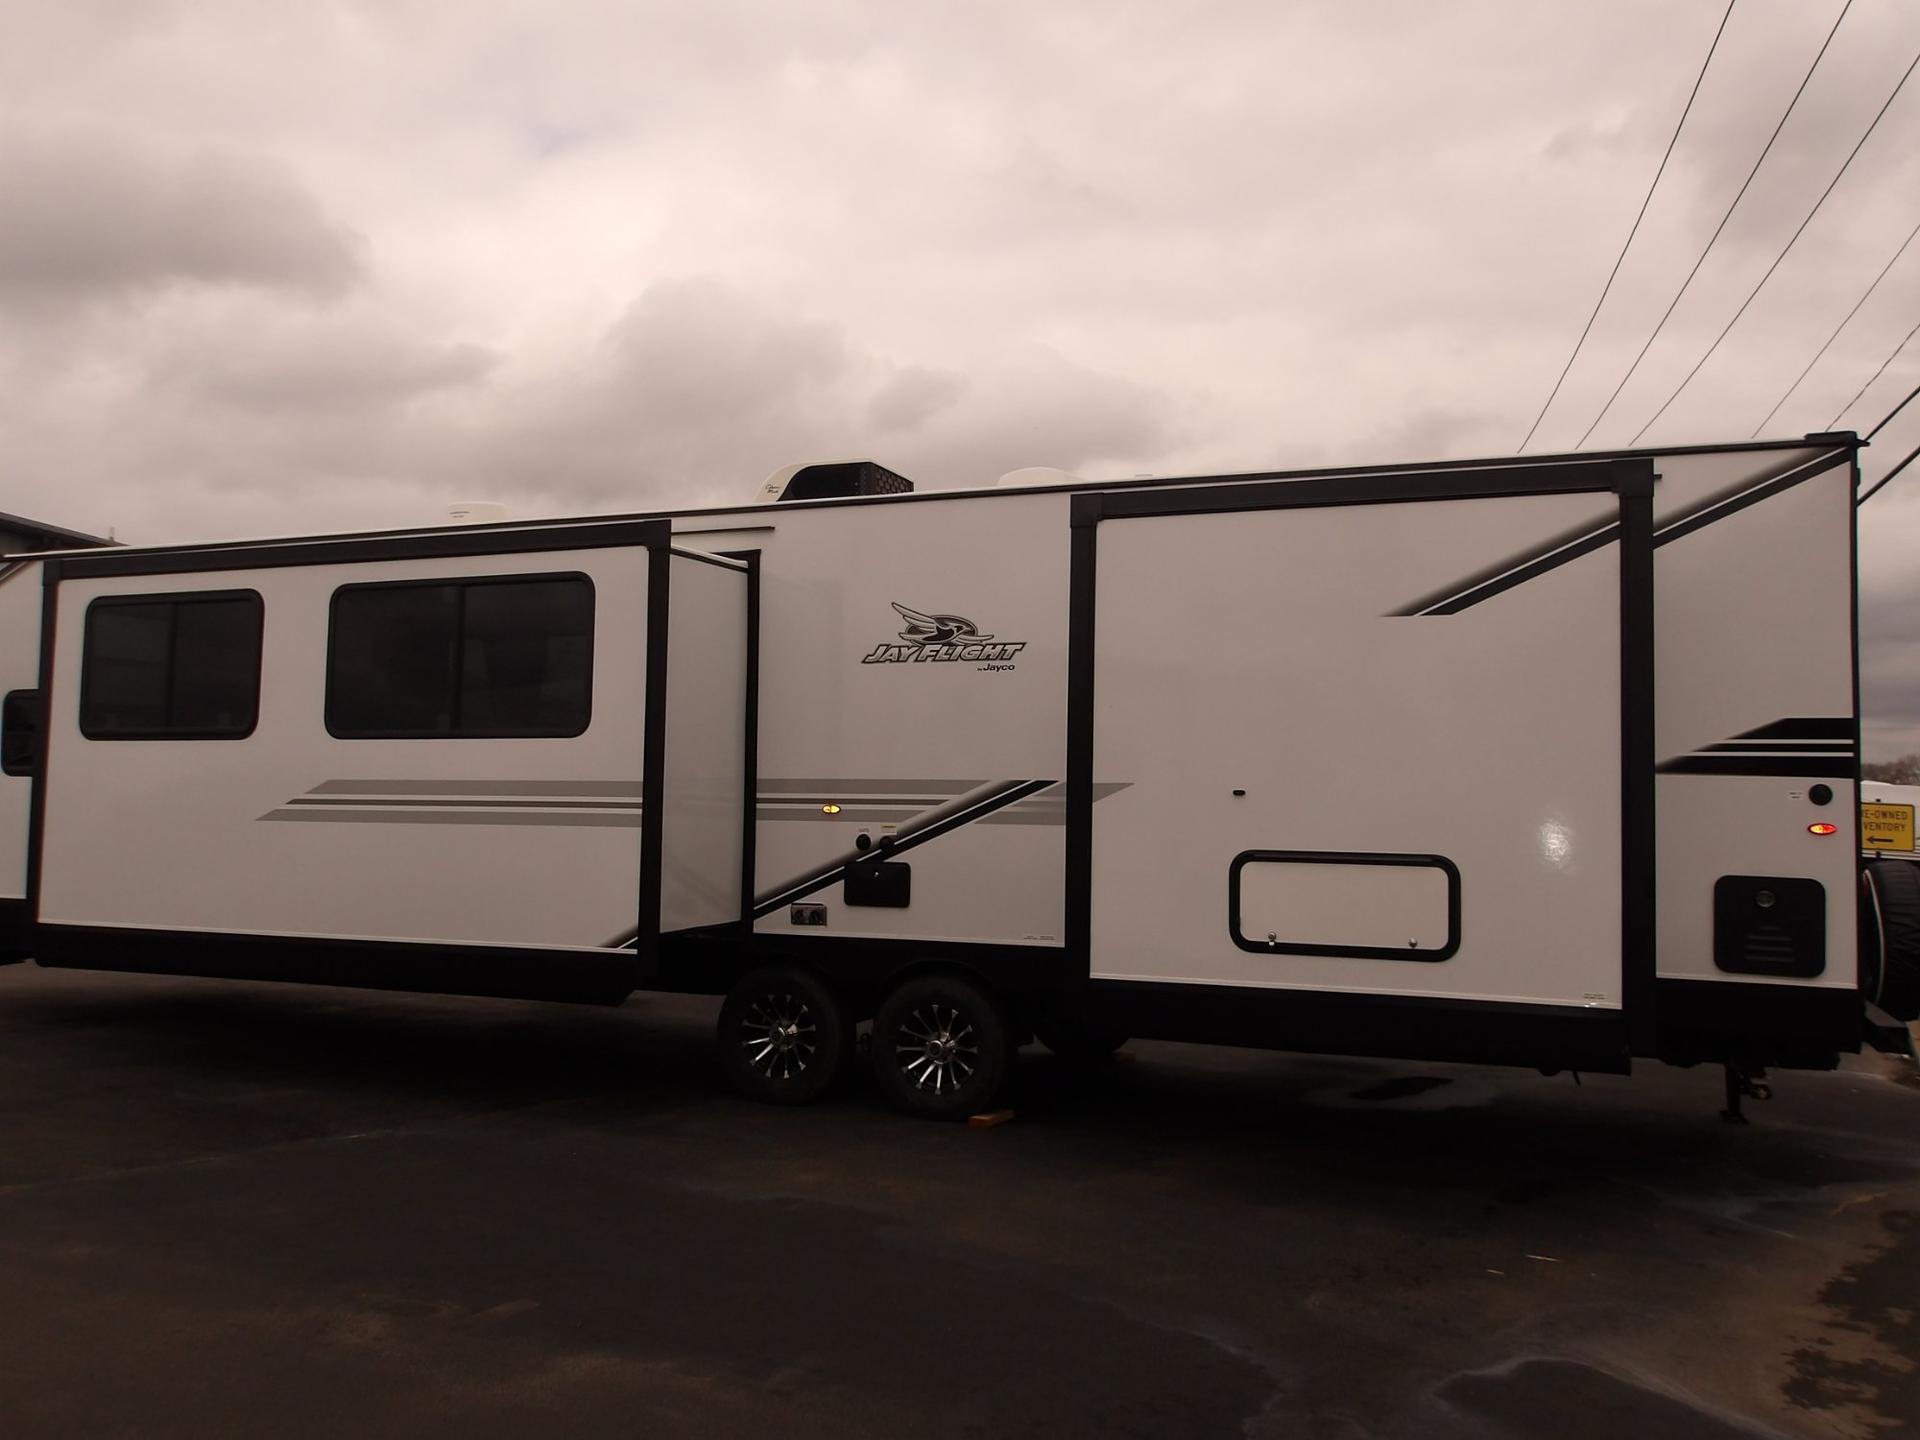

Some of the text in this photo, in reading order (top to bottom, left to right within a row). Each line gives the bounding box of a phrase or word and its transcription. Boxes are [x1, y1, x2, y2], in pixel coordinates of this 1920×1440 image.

[861, 642, 1028, 664] JAY FLIGHT
[983, 663, 1016, 673] Jayco
[1861, 809, 1907, 820] E-OWNED
